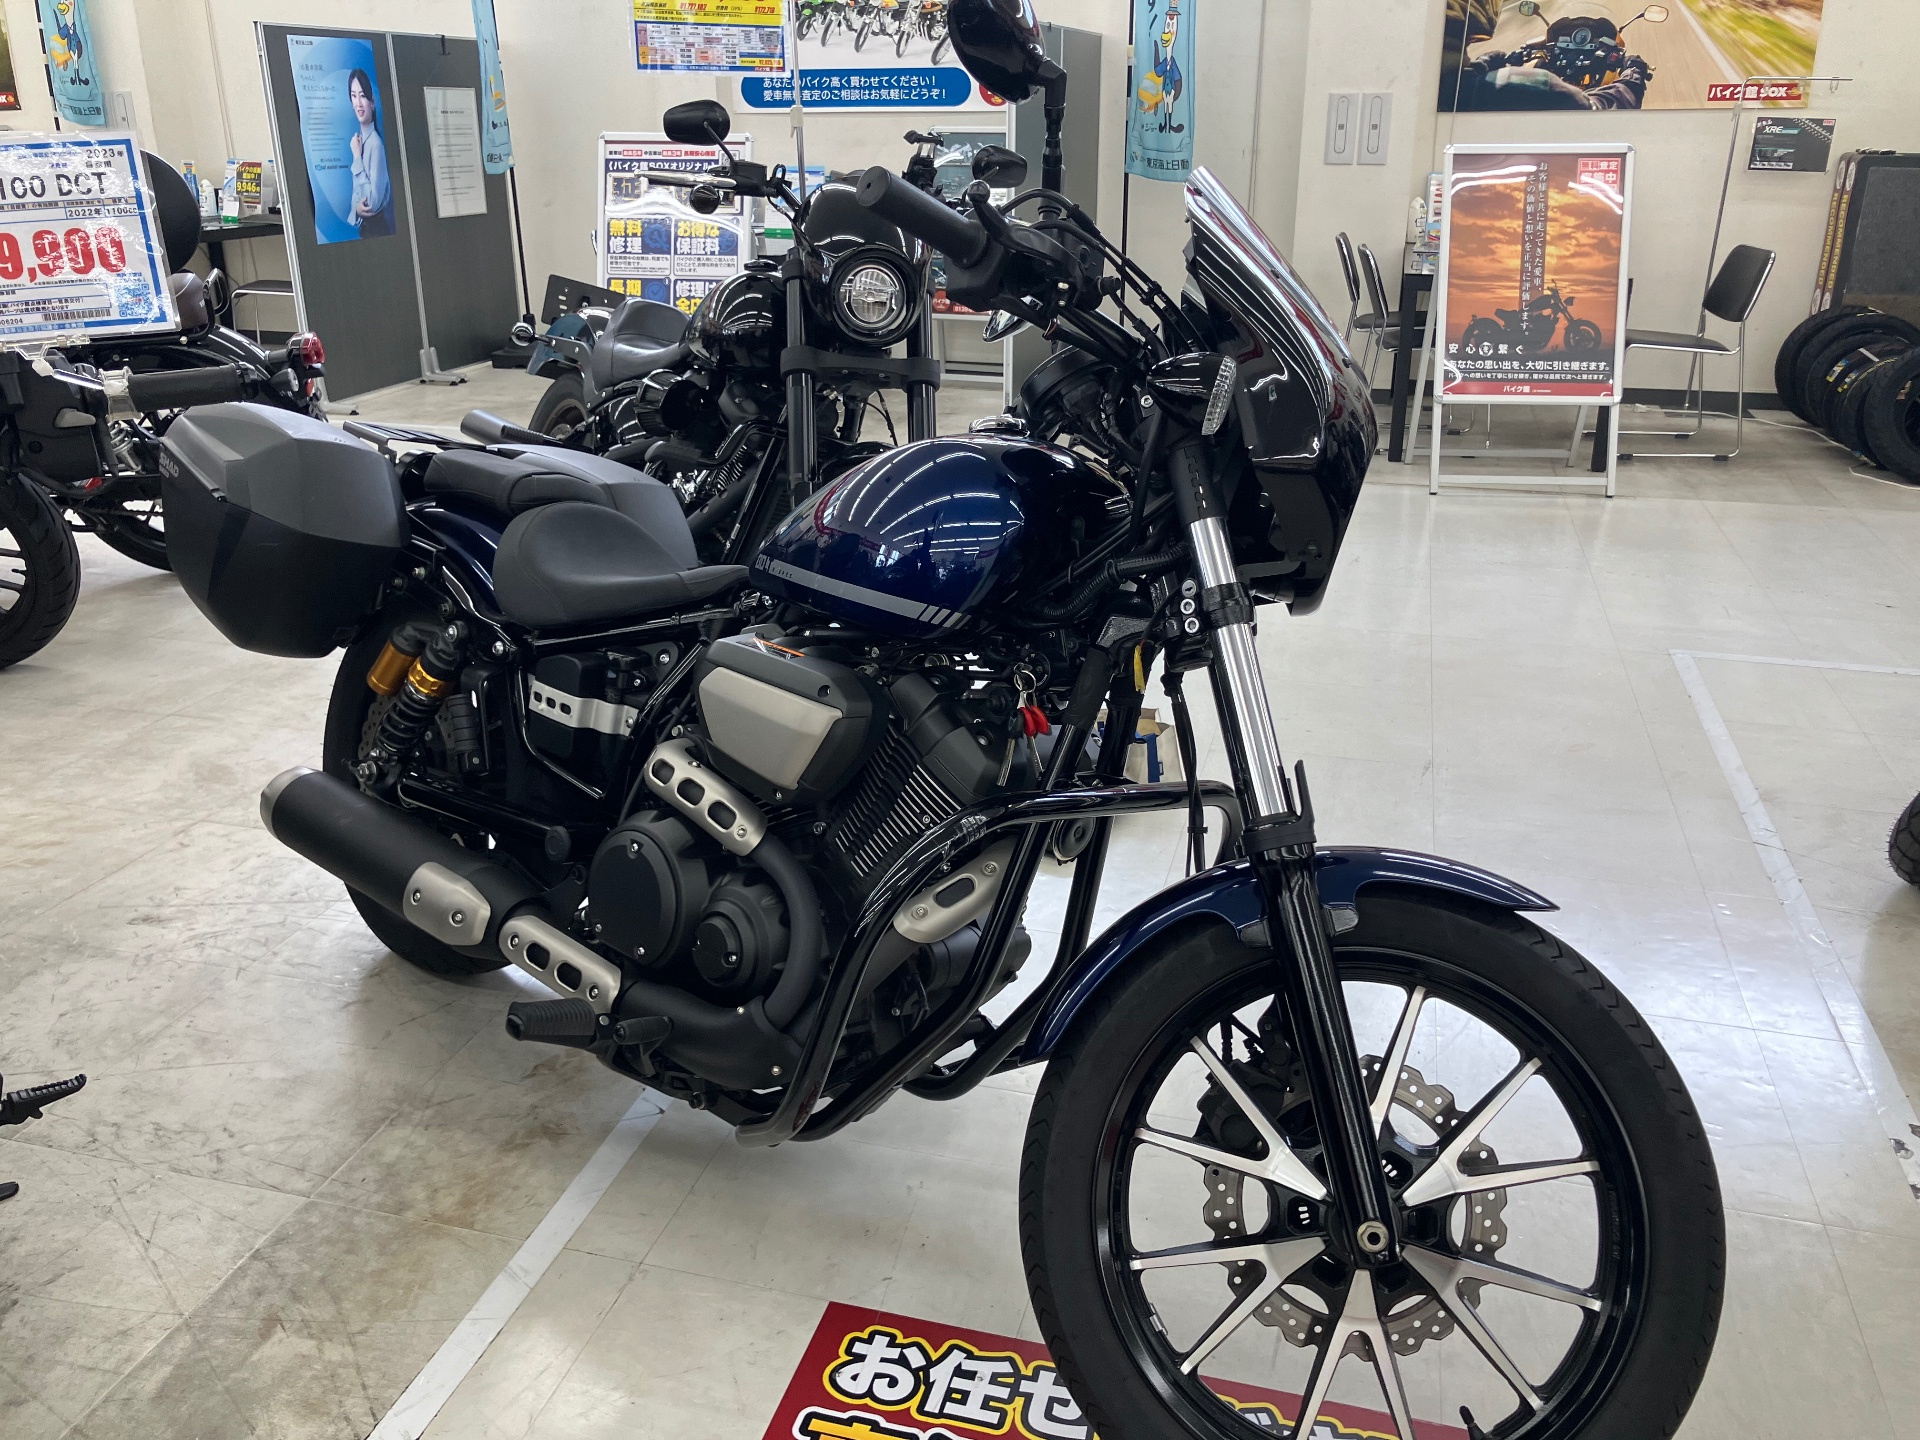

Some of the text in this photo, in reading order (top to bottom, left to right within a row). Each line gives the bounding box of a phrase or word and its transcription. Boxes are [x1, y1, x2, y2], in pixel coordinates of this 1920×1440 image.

[1710, 87, 1758, 98] バイク館
[86, 149, 124, 158] 2023年
[1147, 158, 1189, 170] 東京海上日動
[55, 172, 107, 197] DCT
[68, 208, 102, 217] 2022年
[609, 220, 642, 236] 無料
[678, 221, 720, 237] お得な
[609, 237, 642, 254] 修理
[676, 237, 720, 255] 保証料
[1818, 193, 1838, 285] RECOMMENDED
[1827, 194, 1849, 289] RECOMMENDED
[1520, 175, 1536, 336] その価値と想いを正当に評価します。
[1449, 359, 1609, 371] あなたの思い出を、大切に引き継ぎます。
[1503, 385, 1531, 393] バイク館
